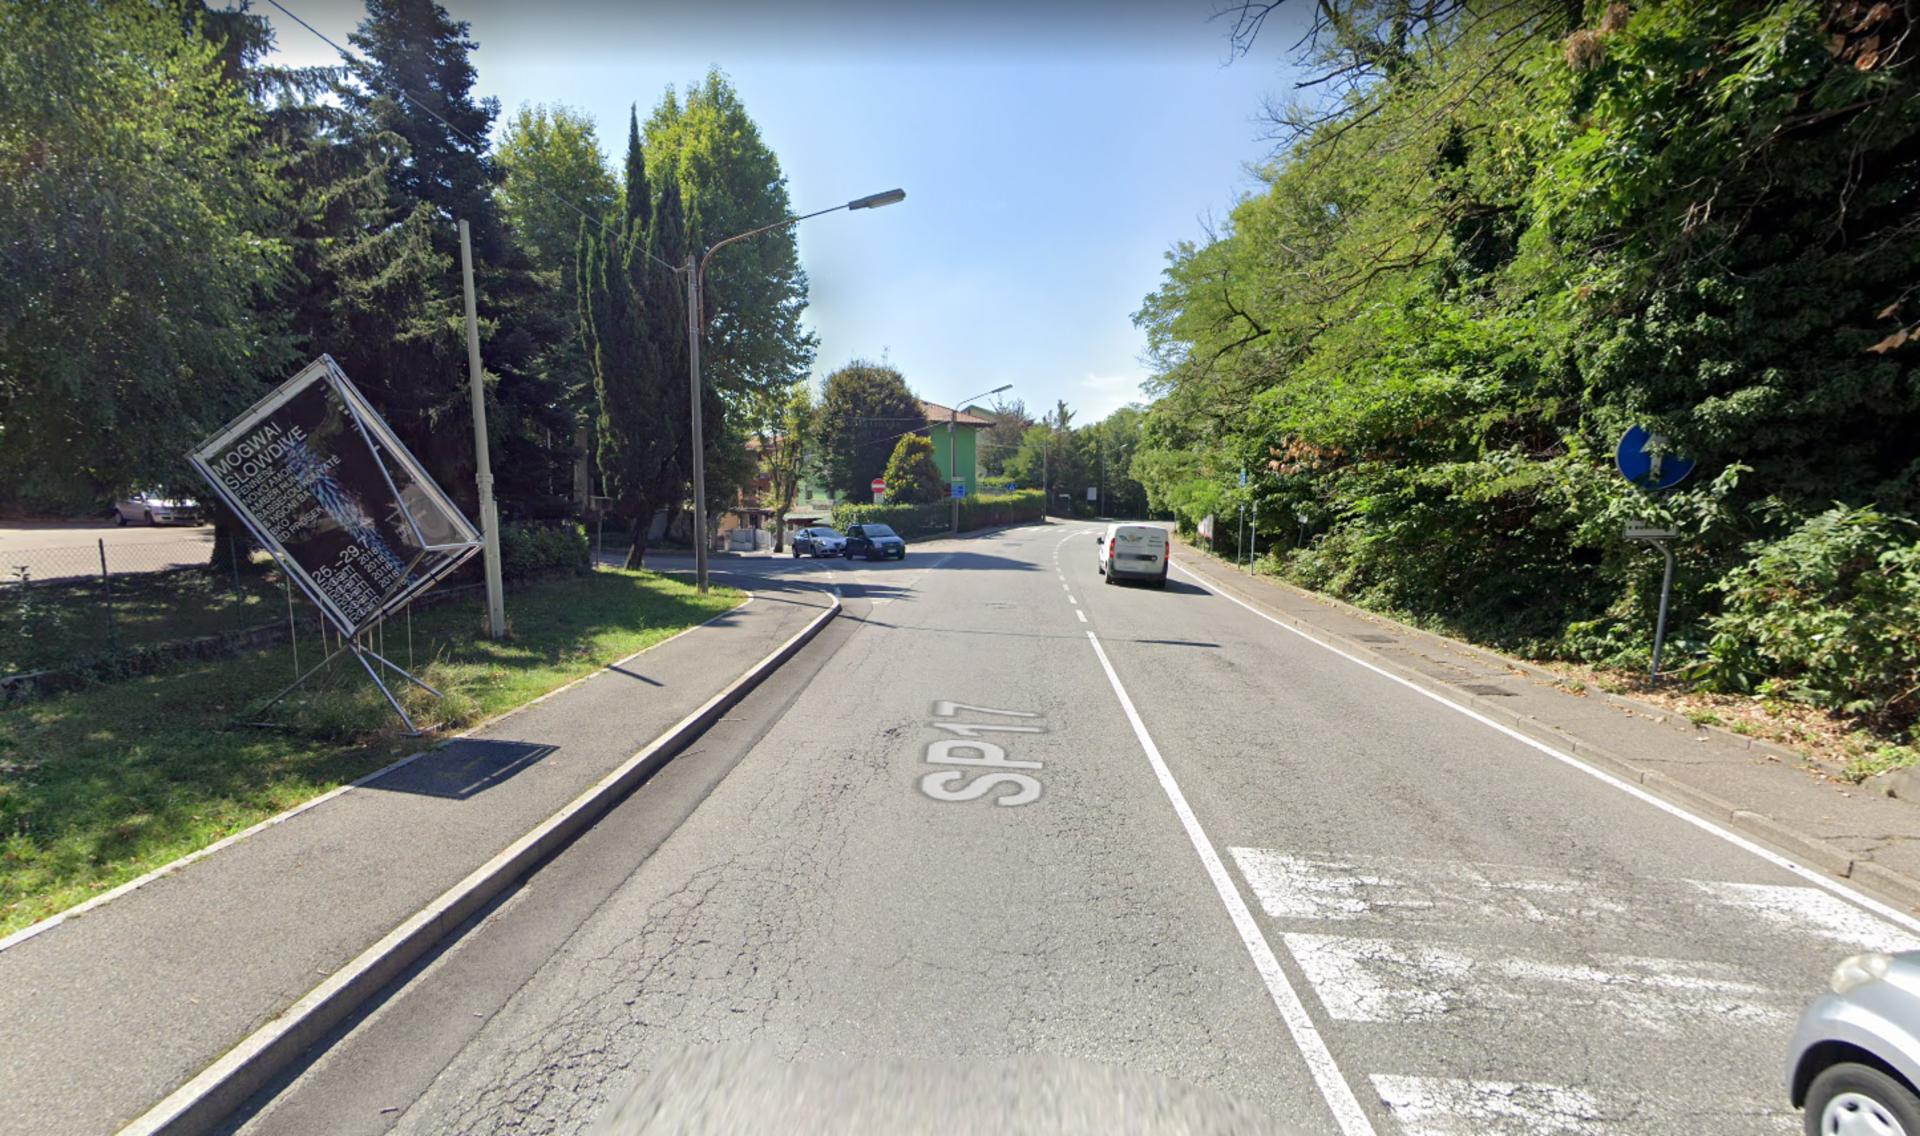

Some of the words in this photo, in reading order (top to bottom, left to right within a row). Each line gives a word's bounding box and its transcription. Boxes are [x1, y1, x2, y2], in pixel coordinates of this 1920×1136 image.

[210, 420, 283, 478] MOGWAI
[222, 424, 308, 492] SLOWDIVE
[269, 517, 290, 536] BKO
[275, 529, 291, 543] ED
